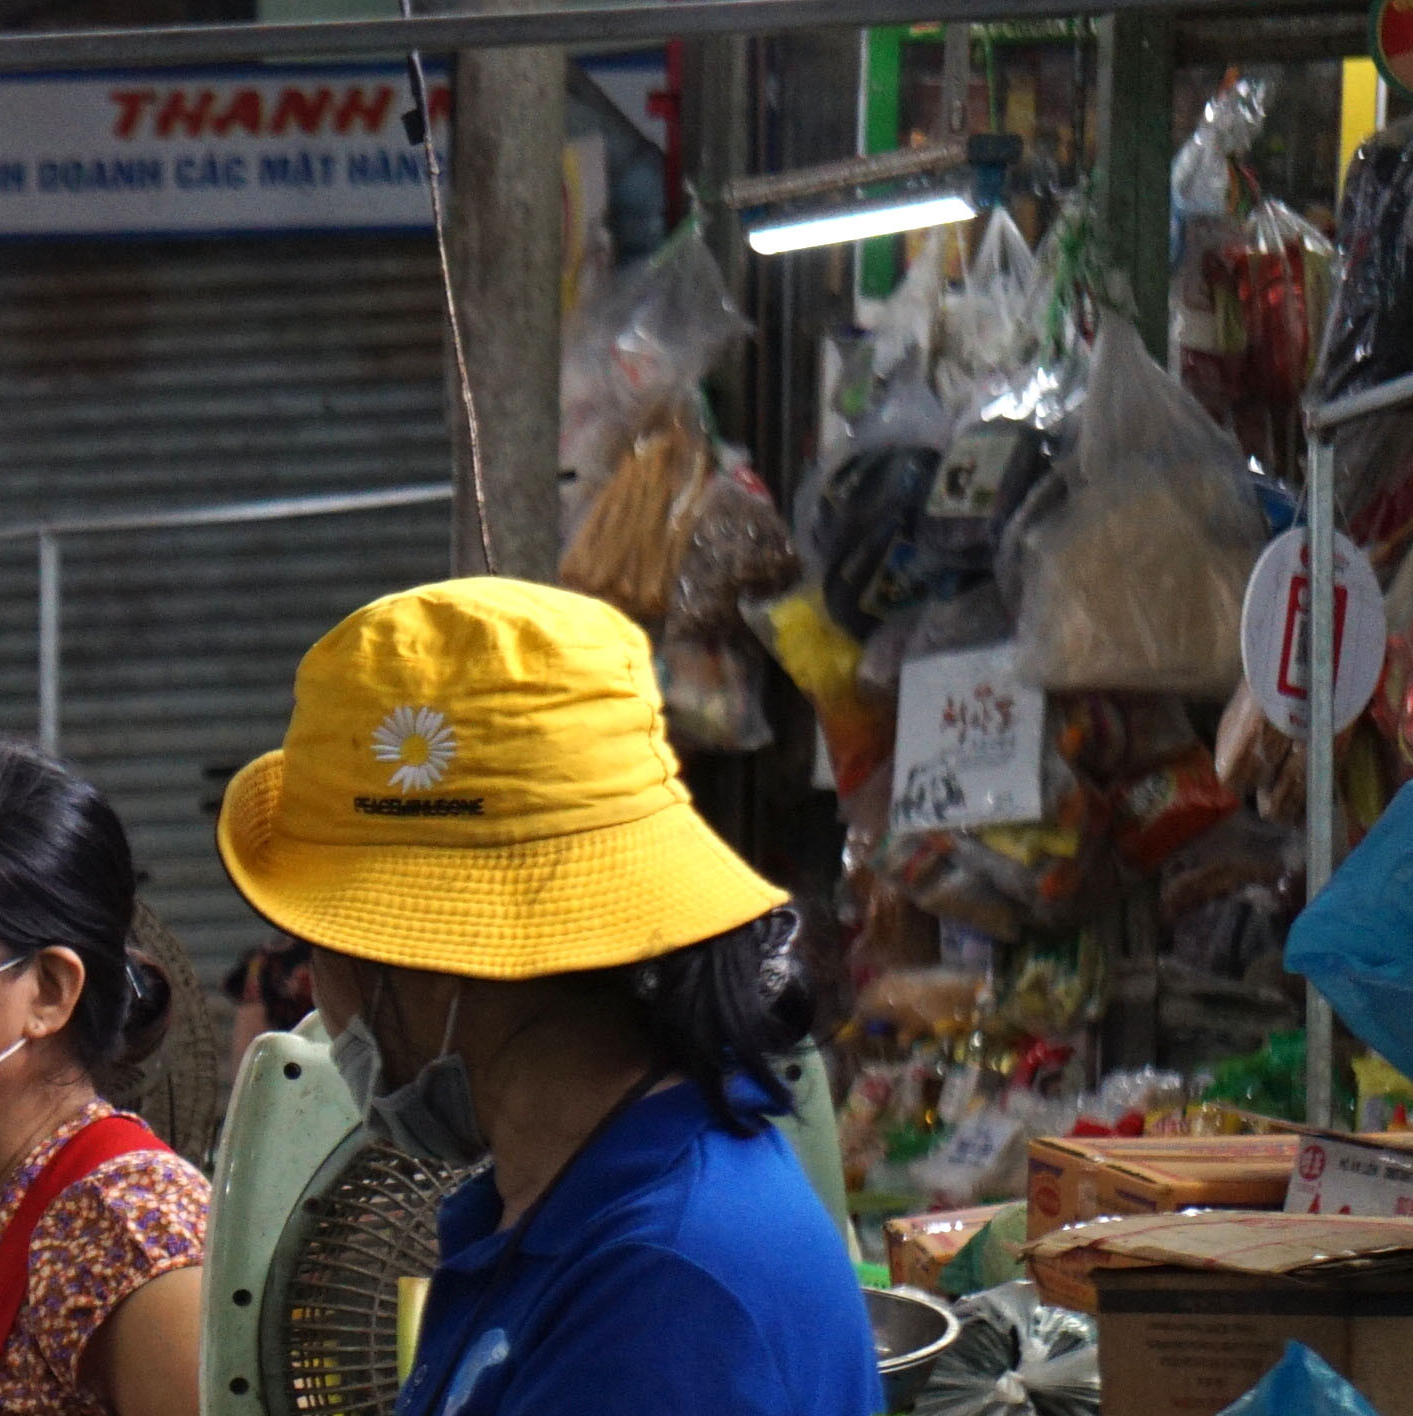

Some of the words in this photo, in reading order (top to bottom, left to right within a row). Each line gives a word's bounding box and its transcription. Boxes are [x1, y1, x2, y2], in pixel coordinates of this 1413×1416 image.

[109, 85, 395, 140] THANH
[37, 155, 163, 193] DOANH
[174, 151, 246, 190] CÁC
